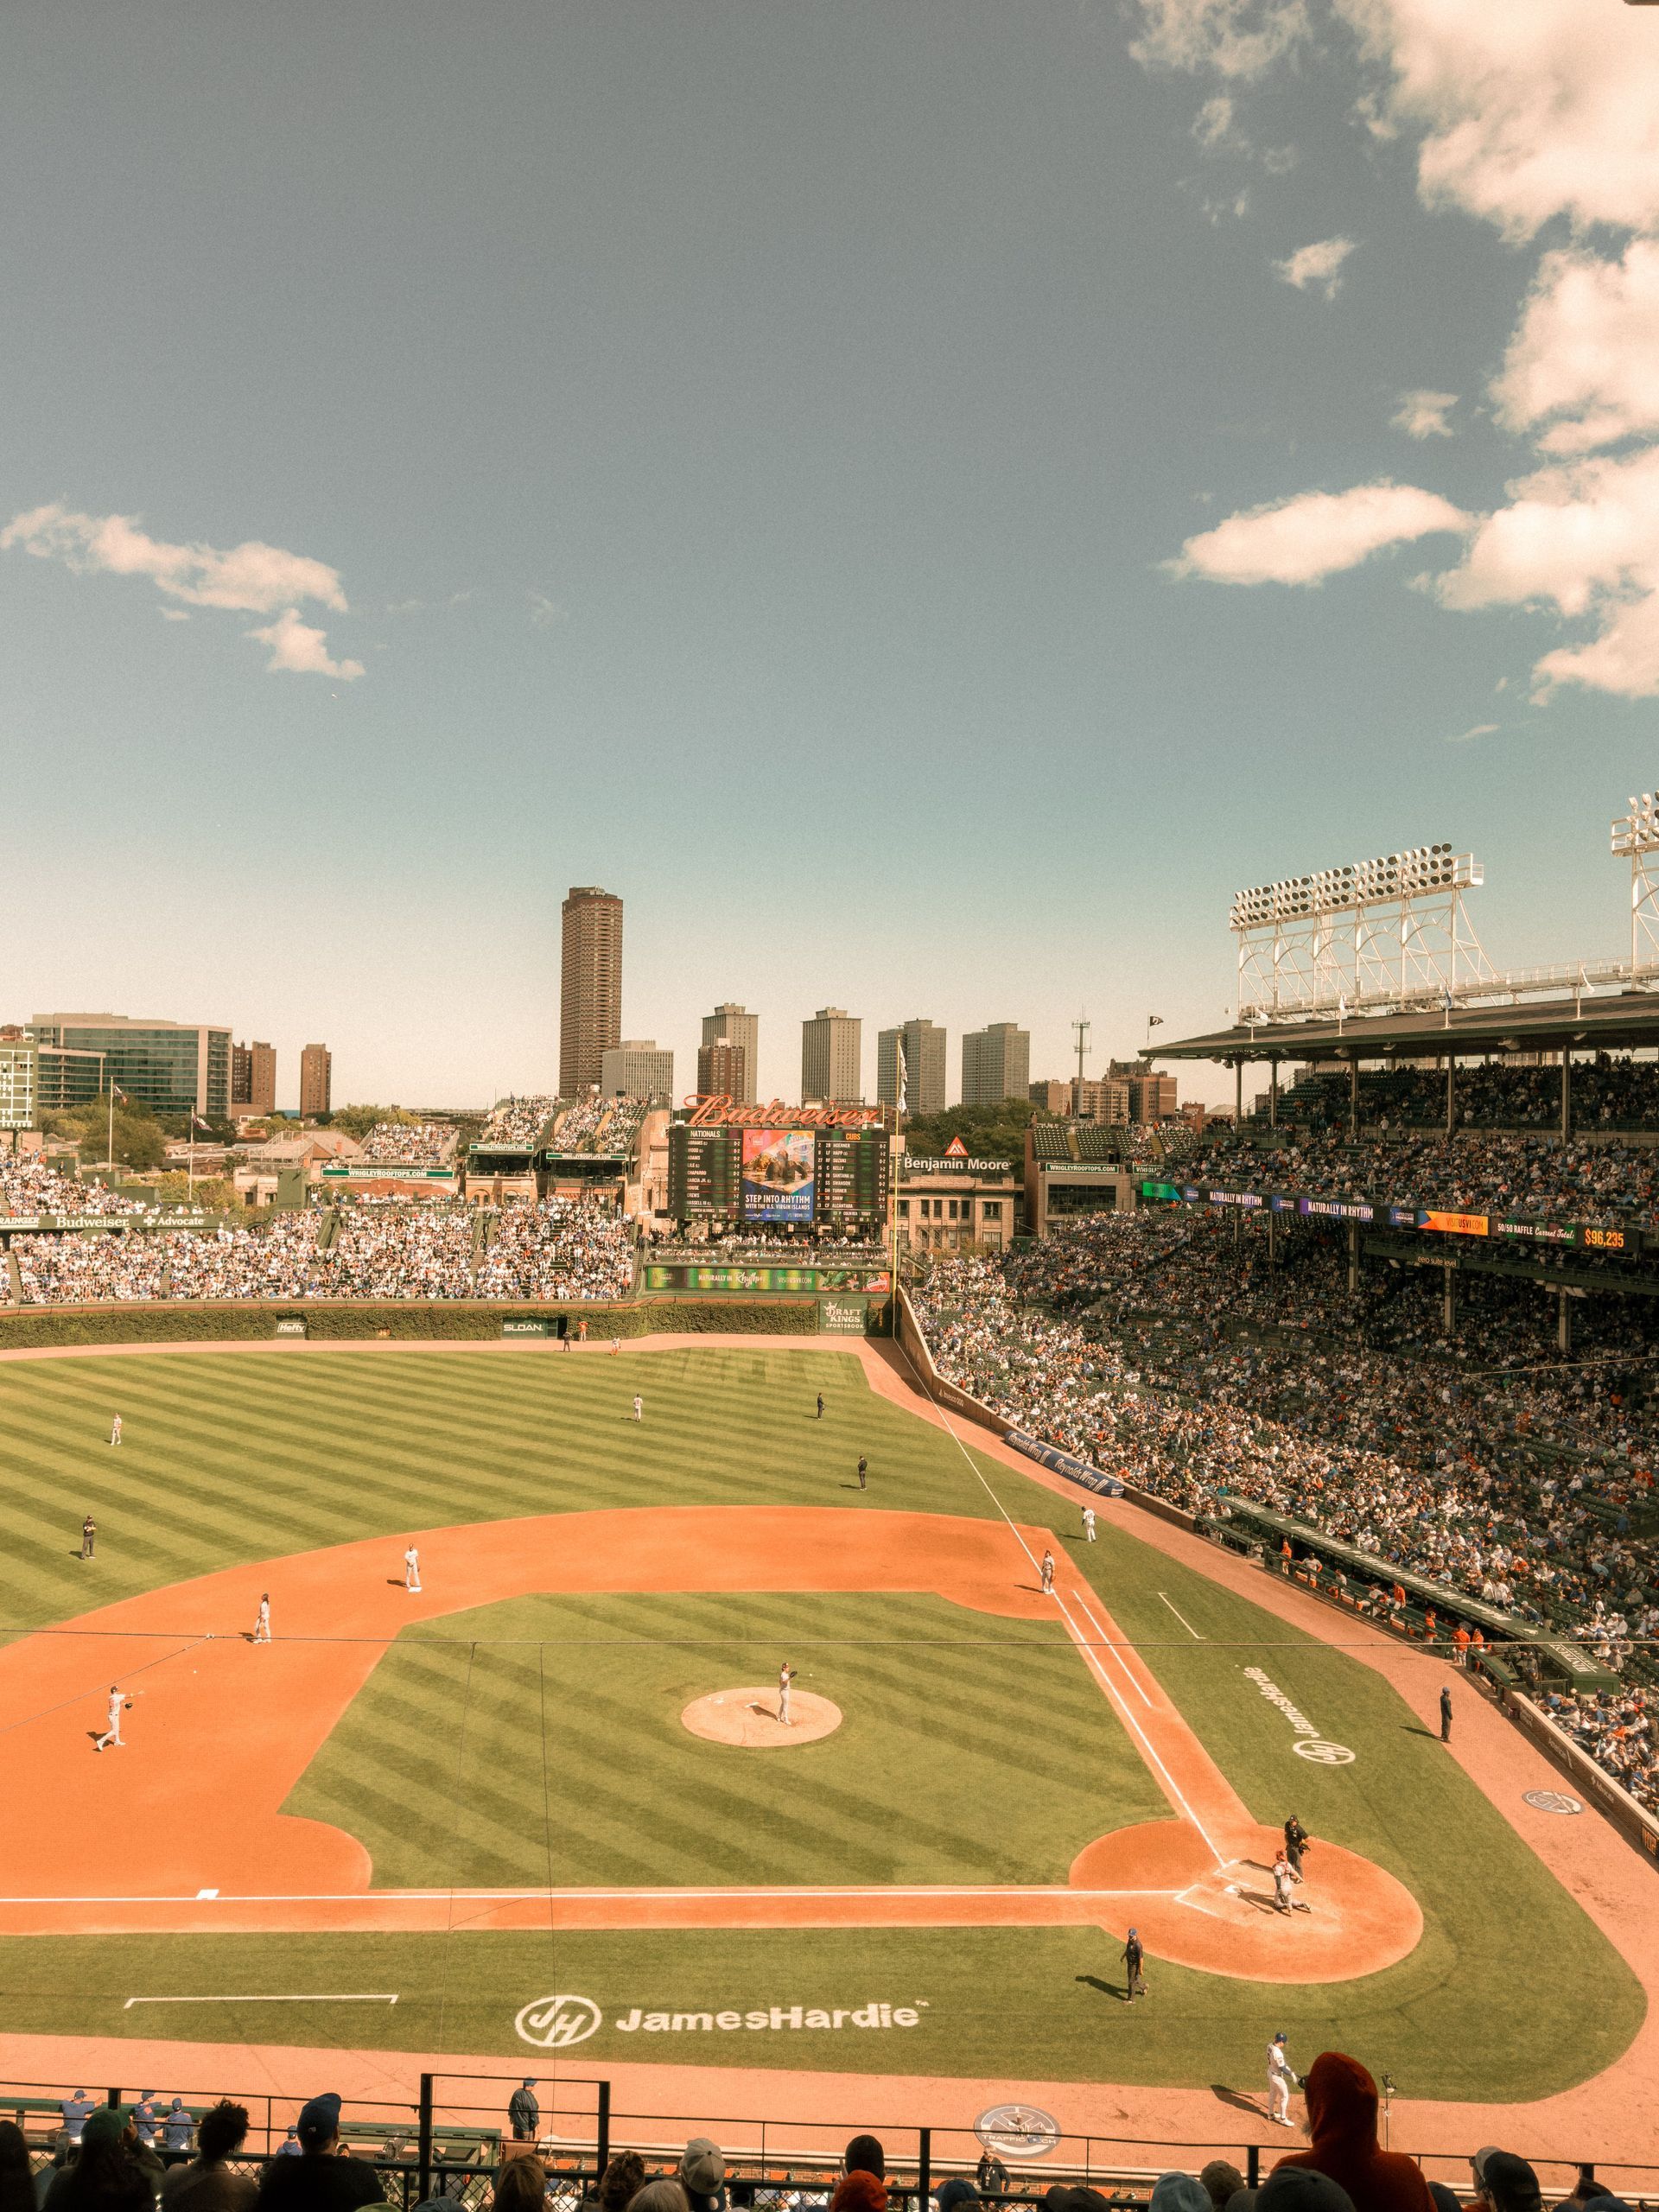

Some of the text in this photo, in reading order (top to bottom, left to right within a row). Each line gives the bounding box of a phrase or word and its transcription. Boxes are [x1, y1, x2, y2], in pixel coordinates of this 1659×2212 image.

[684, 1094, 878, 1126] Budweiser
[905, 1157, 1009, 1171] Benjamin Moore
[745, 1194, 810, 1204] STEP INTO RHYTHM
[1209, 1191, 1235, 1203] NATURALLY
[1236, 1194, 1241, 1204] IN
[1242, 1195, 1262, 1206] RHYTHM
[1308, 1201, 1339, 1215] NATURALLY
[1341, 1205, 1347, 1215] IN
[1348, 1206, 1374, 1219] RHYTHM
[158, 1217, 204, 1225] Advocate
[1497, 1223, 1575, 1239] 50/50 RAFFLE Current Total:
[1585, 1227, 1624, 1248] $96,235
[1430, 1257, 1444, 1266] suite
[1444, 1259, 1456, 1267] level
[826, 1308, 862, 1317] DRAFT
[280, 1323, 304, 1333] Hefty
[1008, 1433, 1042, 1459] Reynolds Wrap
[1055, 1458, 1098, 1488] Reynolds Wrap
